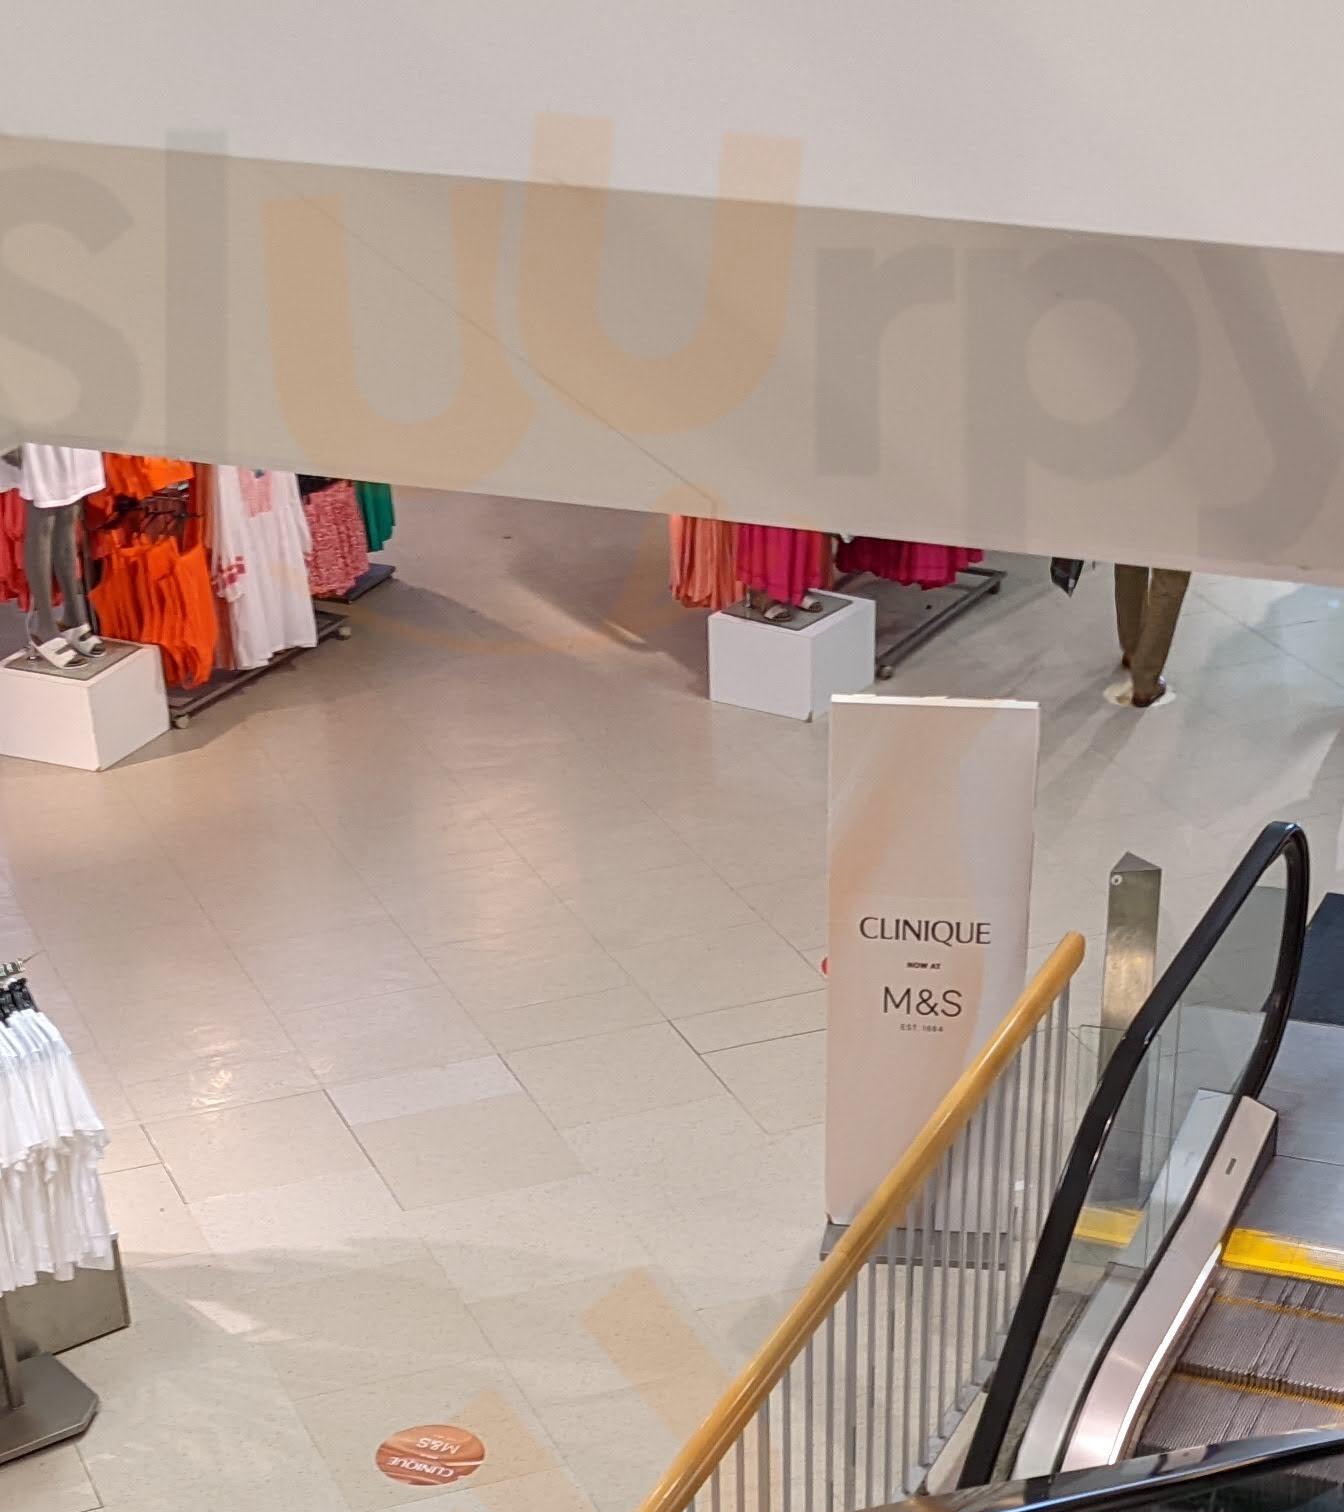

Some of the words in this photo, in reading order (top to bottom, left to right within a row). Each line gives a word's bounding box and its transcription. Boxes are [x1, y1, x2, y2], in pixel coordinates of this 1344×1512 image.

[859, 916, 992, 947] CLINIQUE
[906, 961, 929, 969] NOW
[883, 985, 963, 1018] M&S
[416, 1437, 462, 1455] M&S
[387, 1456, 455, 1478] CLINIQUE
